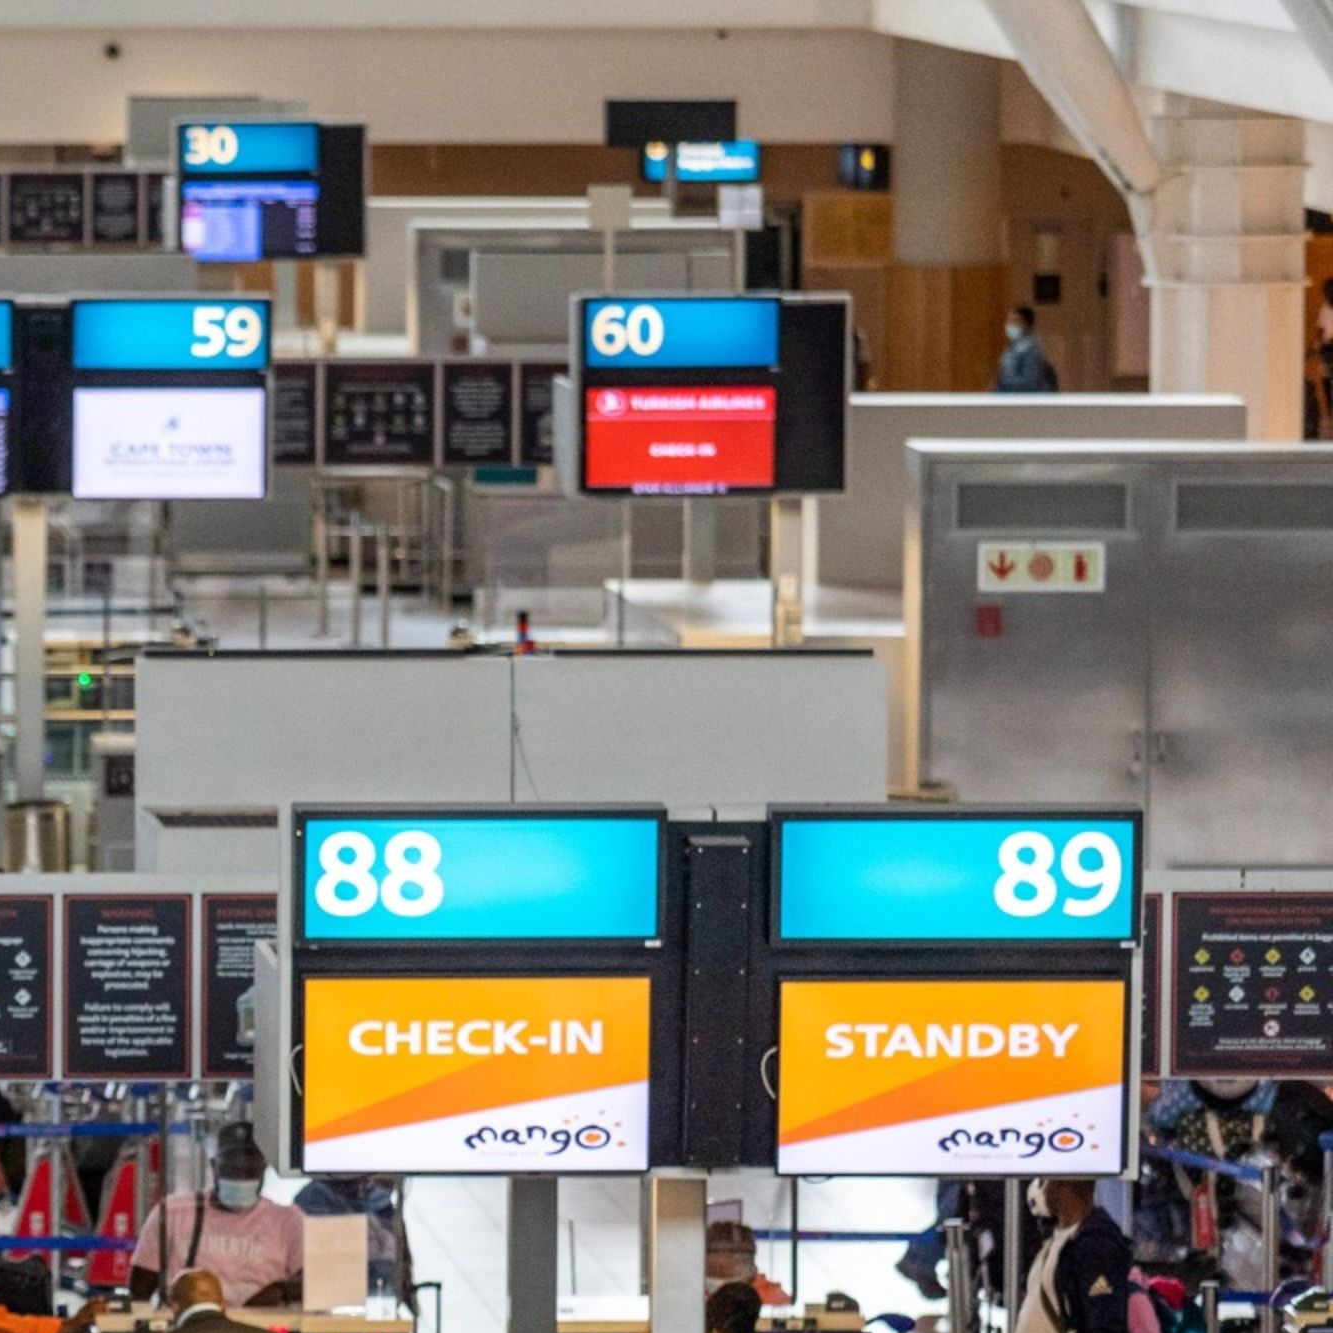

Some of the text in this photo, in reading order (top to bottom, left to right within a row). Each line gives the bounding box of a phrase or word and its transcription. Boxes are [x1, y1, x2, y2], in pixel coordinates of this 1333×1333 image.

[186, 126, 237, 164] 30
[192, 307, 261, 356] 59
[592, 305, 663, 355] 60
[316, 832, 443, 916] 88
[995, 832, 1121, 916] 89
[348, 1020, 604, 1055] CHECK-IN
[824, 1023, 1079, 1059] STANDBY
[464, 1124, 611, 1155] mango
[938, 1126, 1085, 1158] mango
